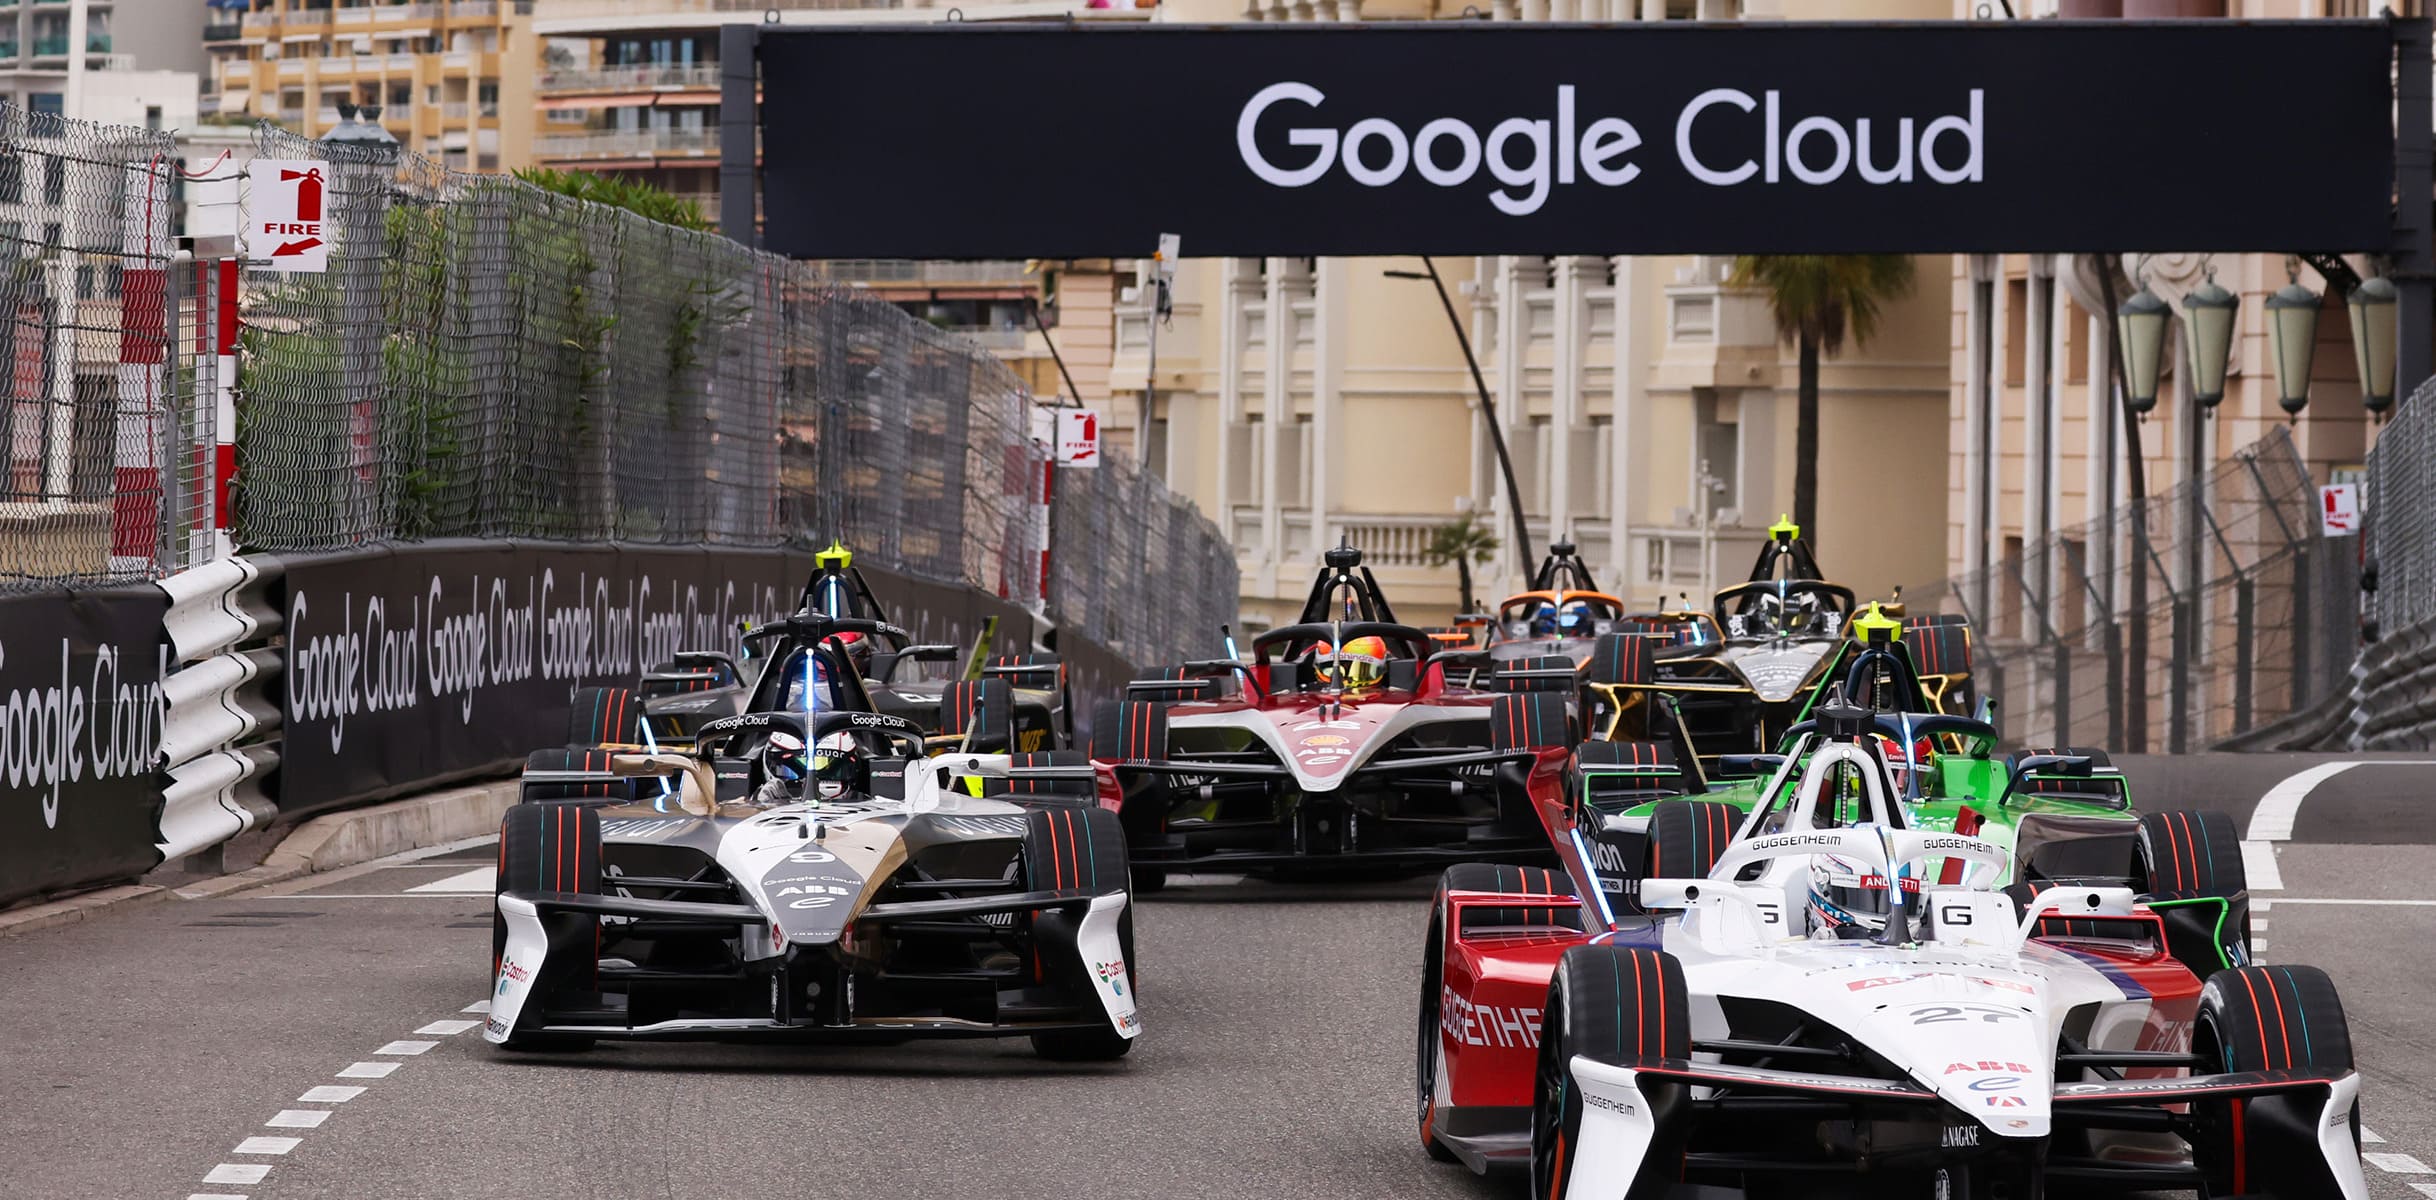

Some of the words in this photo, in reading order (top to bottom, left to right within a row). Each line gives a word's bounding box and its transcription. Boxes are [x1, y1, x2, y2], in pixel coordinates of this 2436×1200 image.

[1236, 81, 1642, 215] Google
[1675, 88, 1984, 185] Cloud
[264, 222, 321, 236] FIRE
[541, 568, 592, 704] Google
[595, 577, 633, 678] Cloud
[427, 575, 487, 725] Google
[490, 575, 534, 686] Cloud
[289, 590, 359, 754] Google
[364, 595, 418, 712] Cloud
[715, 715, 744, 730] Google
[745, 715, 769, 726] Cloud
[851, 714, 882, 728] Google
[883, 716, 905, 728] Cloud
[0, 638, 84, 829] oogle
[1752, 835, 1841, 850] GUGGENHEIM
[1924, 838, 1993, 854] GUGGENHEIM
[789, 851, 836, 863] 9
[764, 876, 817, 886] Google
[820, 876, 862, 885] Cloud
[776, 885, 849, 897] ABB
[1943, 905, 1972, 925] G
[1442, 984, 1545, 1048] GUGGENHE
[1909, 1006, 2020, 1025] 27
[1944, 1061, 2032, 1075] ABB
[1584, 1092, 1635, 1117] GUGGENHEIM
[1948, 1126, 1980, 1147] NAGASE
